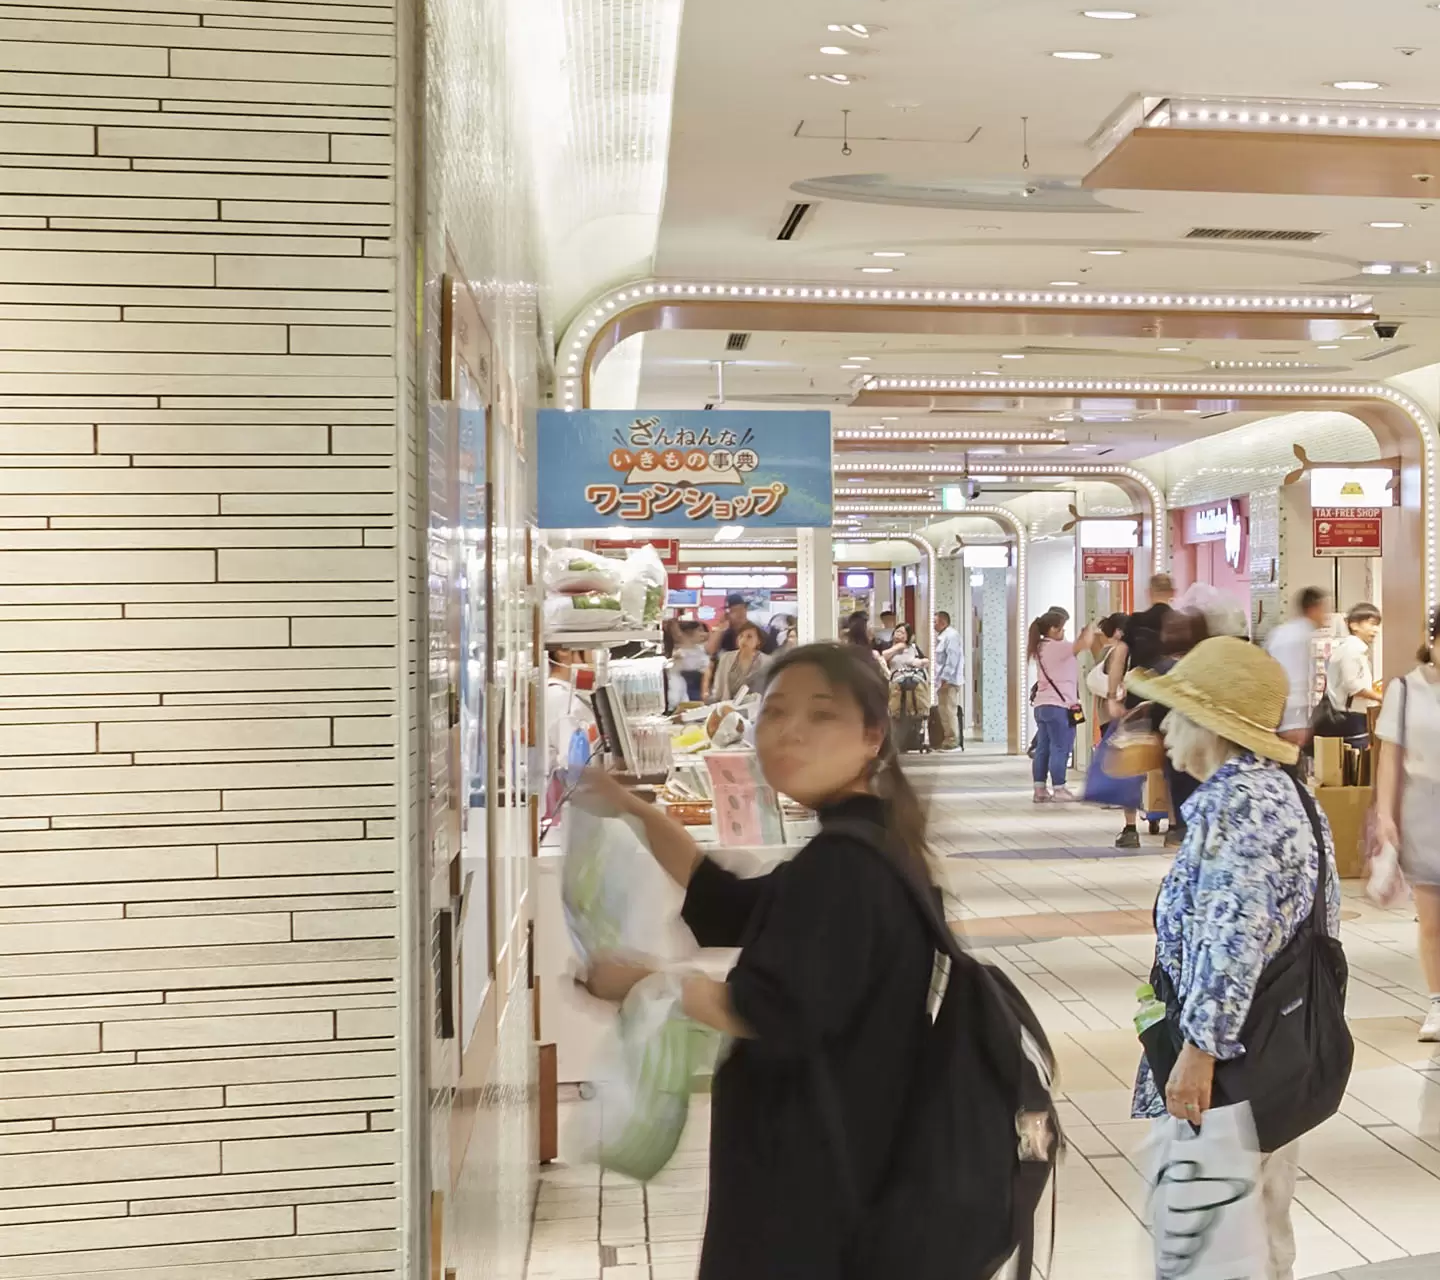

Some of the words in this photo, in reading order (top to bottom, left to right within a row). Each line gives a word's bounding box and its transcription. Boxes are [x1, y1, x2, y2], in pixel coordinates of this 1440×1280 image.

[629, 417, 738, 447] ざんねんな
[611, 450, 757, 471] いきもの事典
[585, 482, 789, 521] ワゴンショップ
[1315, 507, 1355, 518] TAX-FREE
[1356, 507, 1380, 518] SHOP
